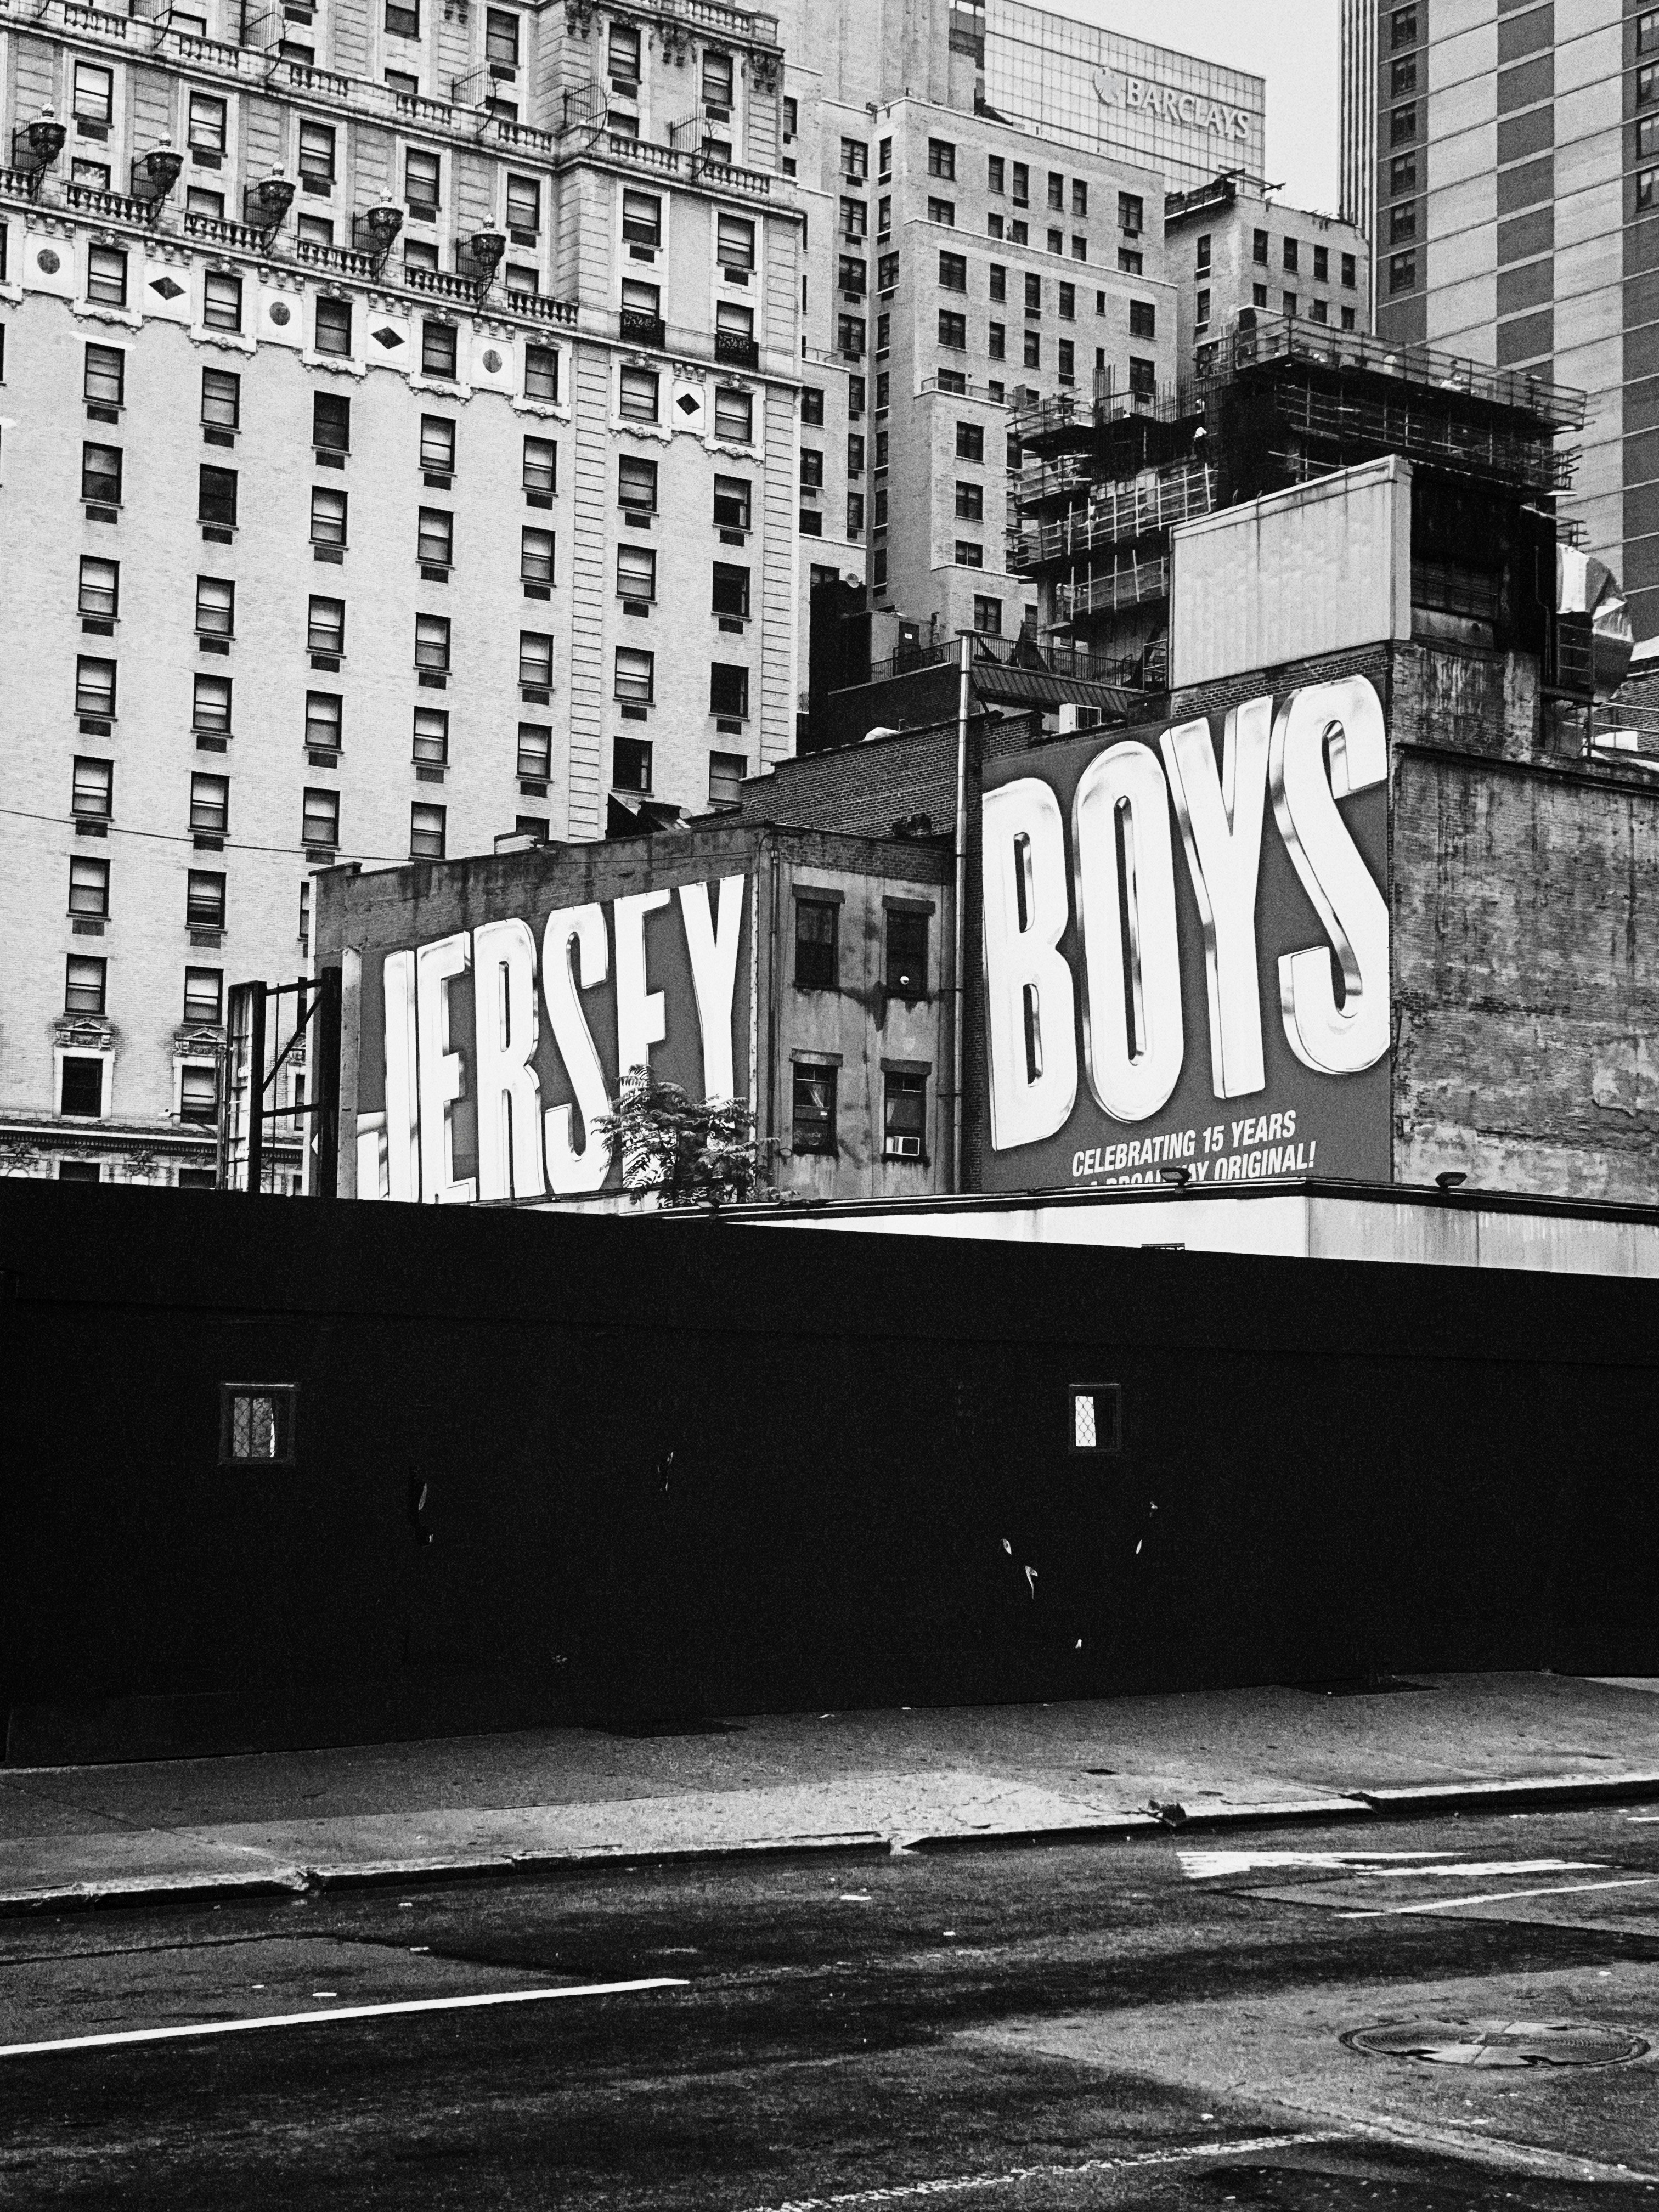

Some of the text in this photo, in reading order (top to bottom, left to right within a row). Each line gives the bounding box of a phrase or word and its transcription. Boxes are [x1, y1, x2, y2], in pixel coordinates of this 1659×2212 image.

[1126, 78, 1250, 138] BARCLAYS
[982, 674, 1390, 1150] BOYS
[357, 874, 744, 1204] JERSEY
[1072, 1130, 1196, 1177] CELEBRATING
[1203, 1125, 1225, 1153] 15
[1231, 1110, 1296, 1148] YEARS
[1214, 1141, 1317, 1180] ORIGINAL!
